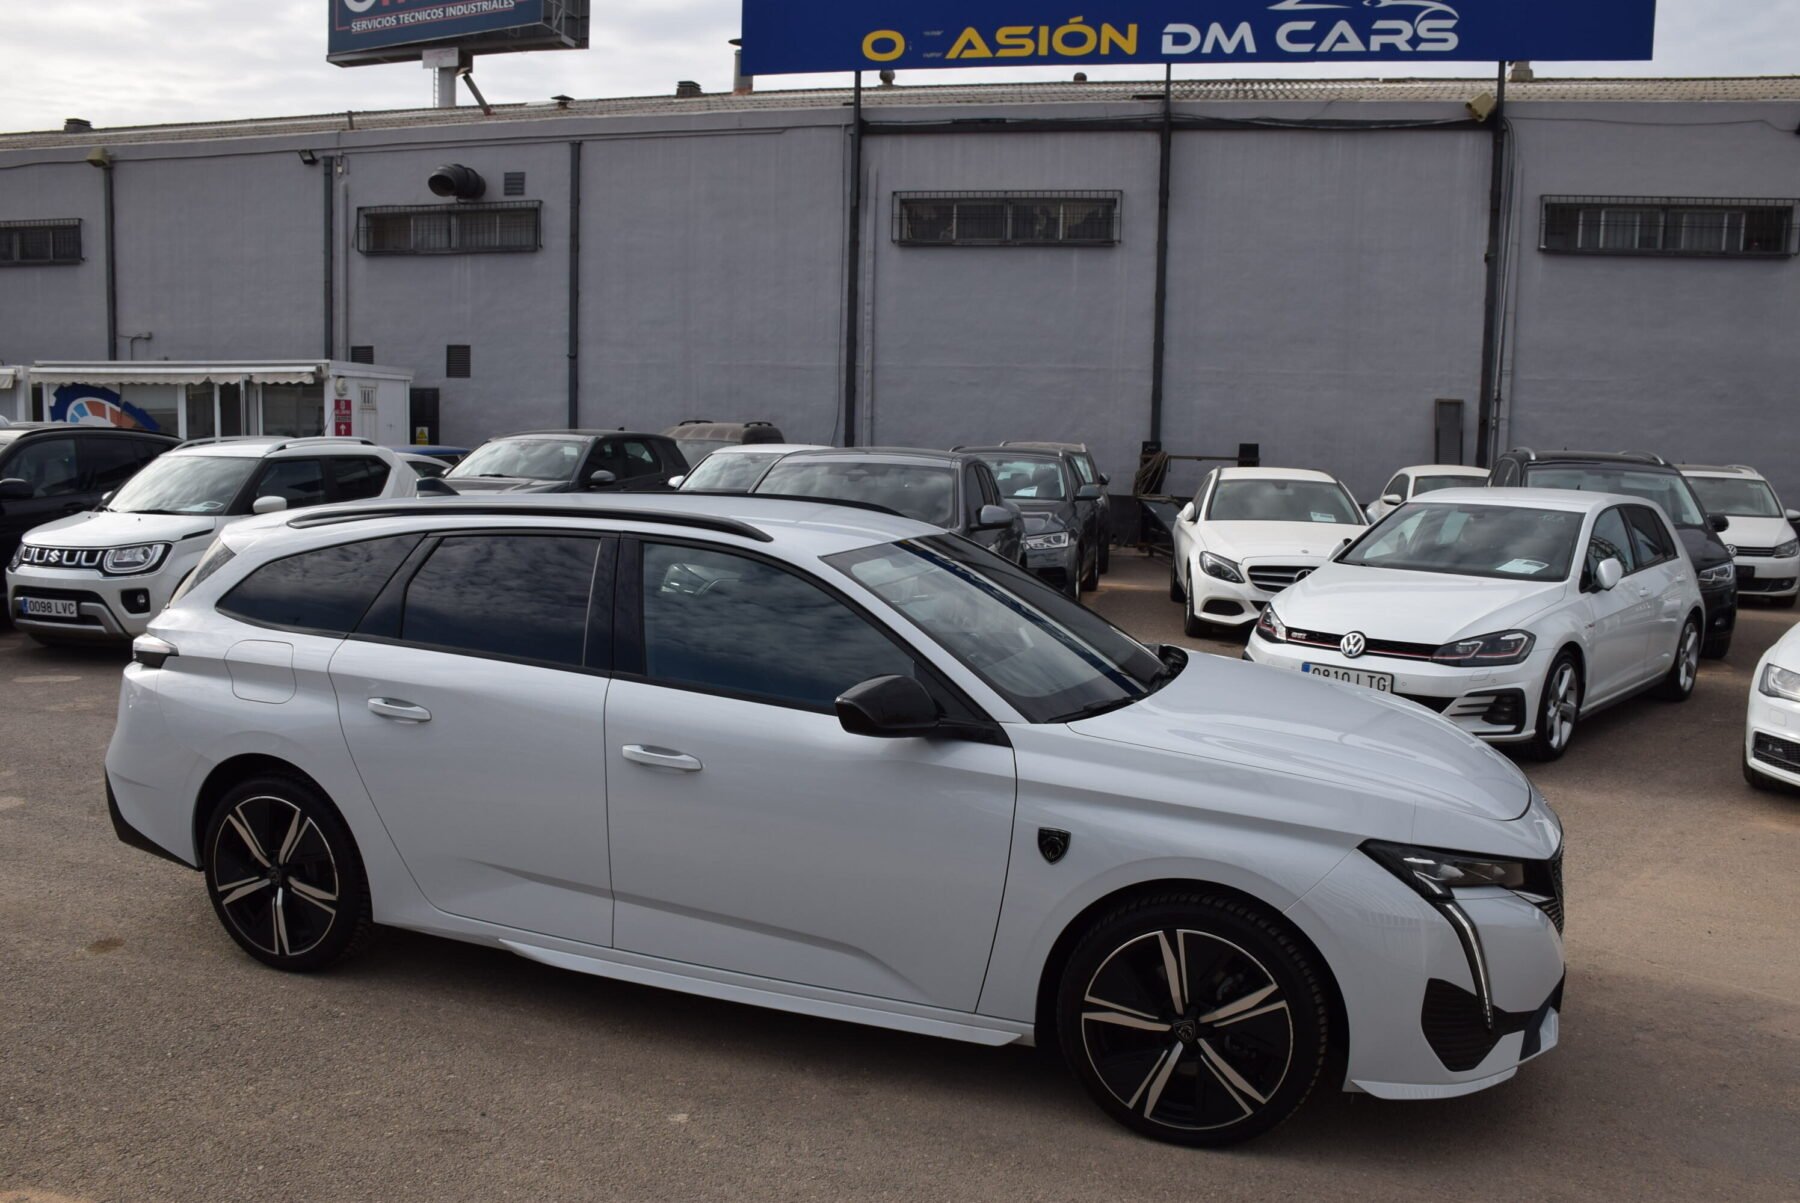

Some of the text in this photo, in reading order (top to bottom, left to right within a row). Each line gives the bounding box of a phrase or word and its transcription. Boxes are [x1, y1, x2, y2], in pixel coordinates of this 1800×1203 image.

[351, 17, 396, 32] SERVICIOS
[445, 0, 515, 17] INDUSTRIALES
[862, 16, 1460, 61] OASIÓN DM CARS
[28, 600, 75, 615] 0098 LVC
